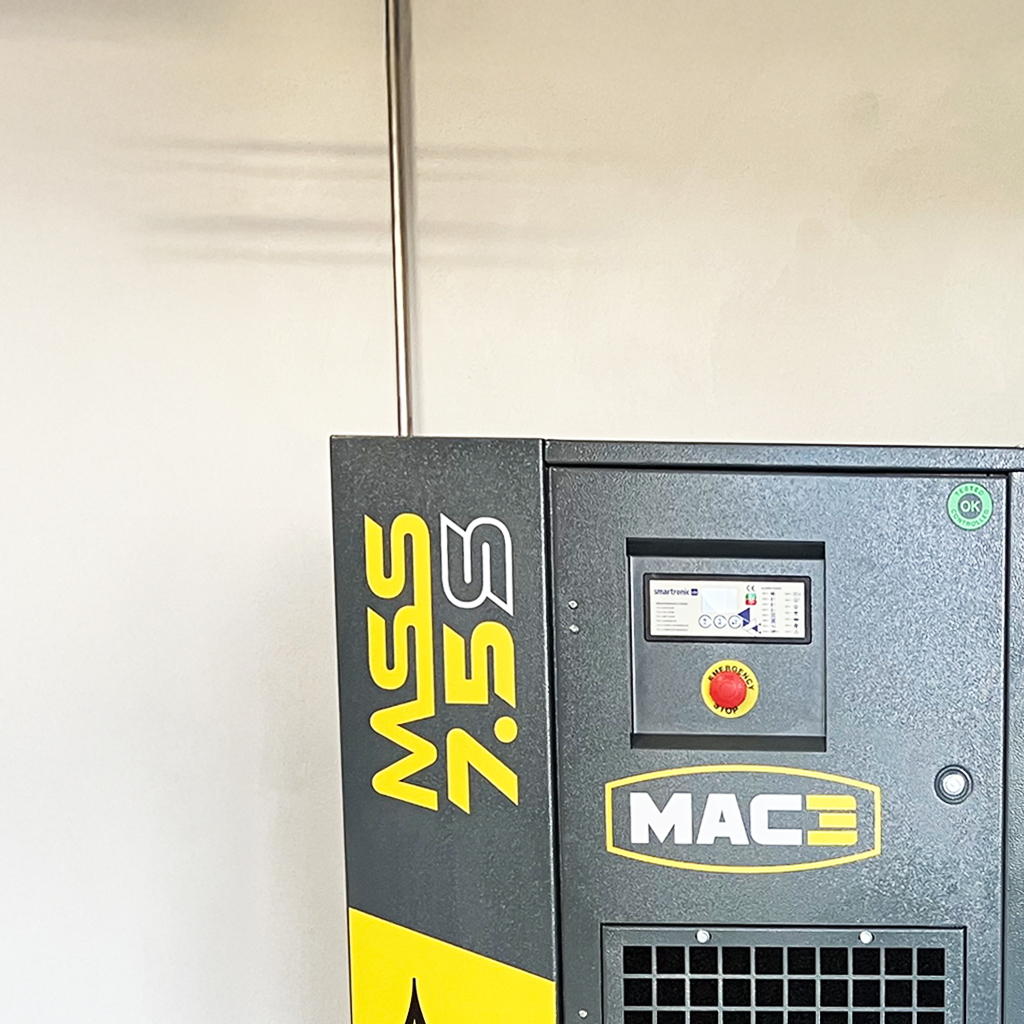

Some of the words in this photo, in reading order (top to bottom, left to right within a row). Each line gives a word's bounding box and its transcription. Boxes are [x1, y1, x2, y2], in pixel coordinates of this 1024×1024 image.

[954, 486, 985, 496] TESTED
[960, 500, 980, 512] OK
[364, 512, 438, 811] MSS
[708, 665, 755, 691] EMERGENCY
[713, 703, 739, 715] STOP
[629, 792, 859, 846] MAC3
